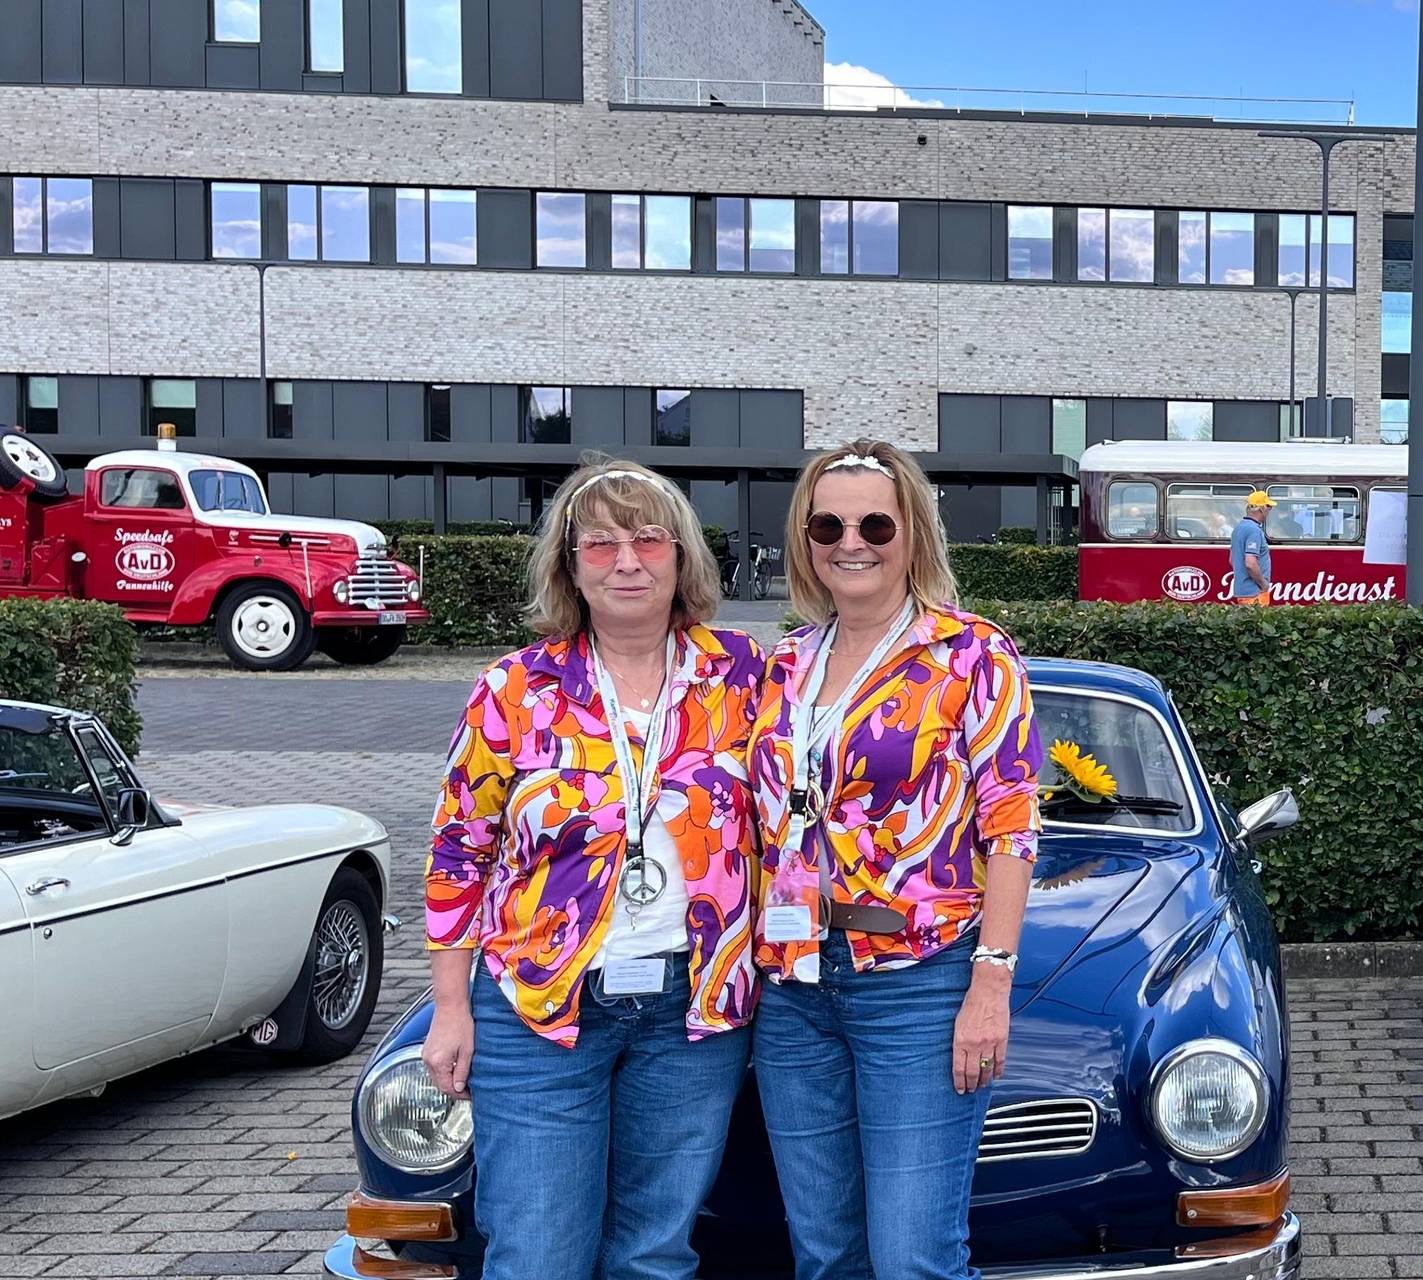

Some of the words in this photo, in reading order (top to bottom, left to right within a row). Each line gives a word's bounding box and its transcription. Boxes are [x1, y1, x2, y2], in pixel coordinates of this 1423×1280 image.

[114, 527, 174, 546] Speedsafe
[127, 553, 162, 570] AvD
[116, 579, 174, 592] Pannenhilfe
[1171, 575, 1201, 592] AvD
[253, 1021, 275, 1041] MG
